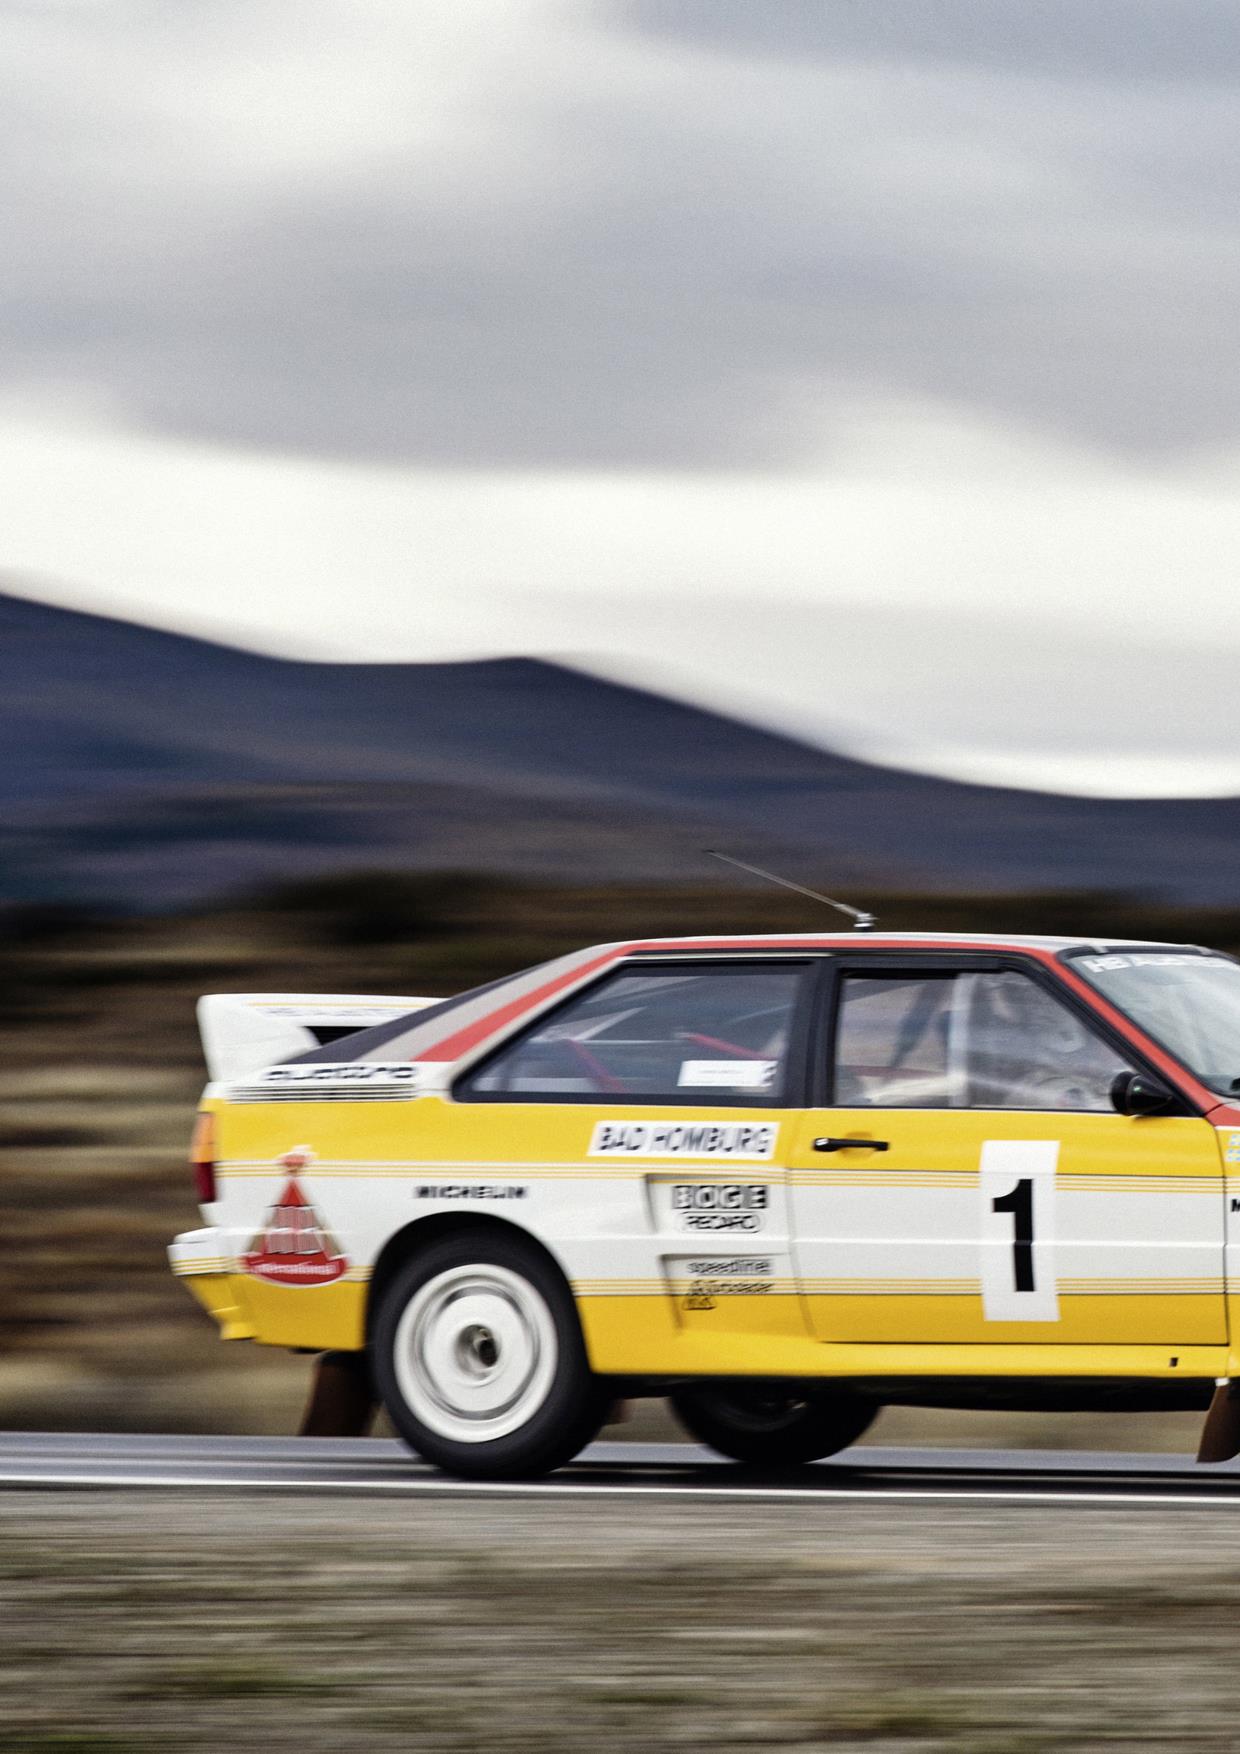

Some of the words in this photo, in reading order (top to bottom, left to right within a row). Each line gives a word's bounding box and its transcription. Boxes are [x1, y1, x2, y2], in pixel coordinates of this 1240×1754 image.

[600, 1127, 646, 1151] BAD
[652, 1128, 774, 1153] HOMBURG
[671, 1185, 768, 1209] BOGE
[992, 1178, 1035, 1292] 1
